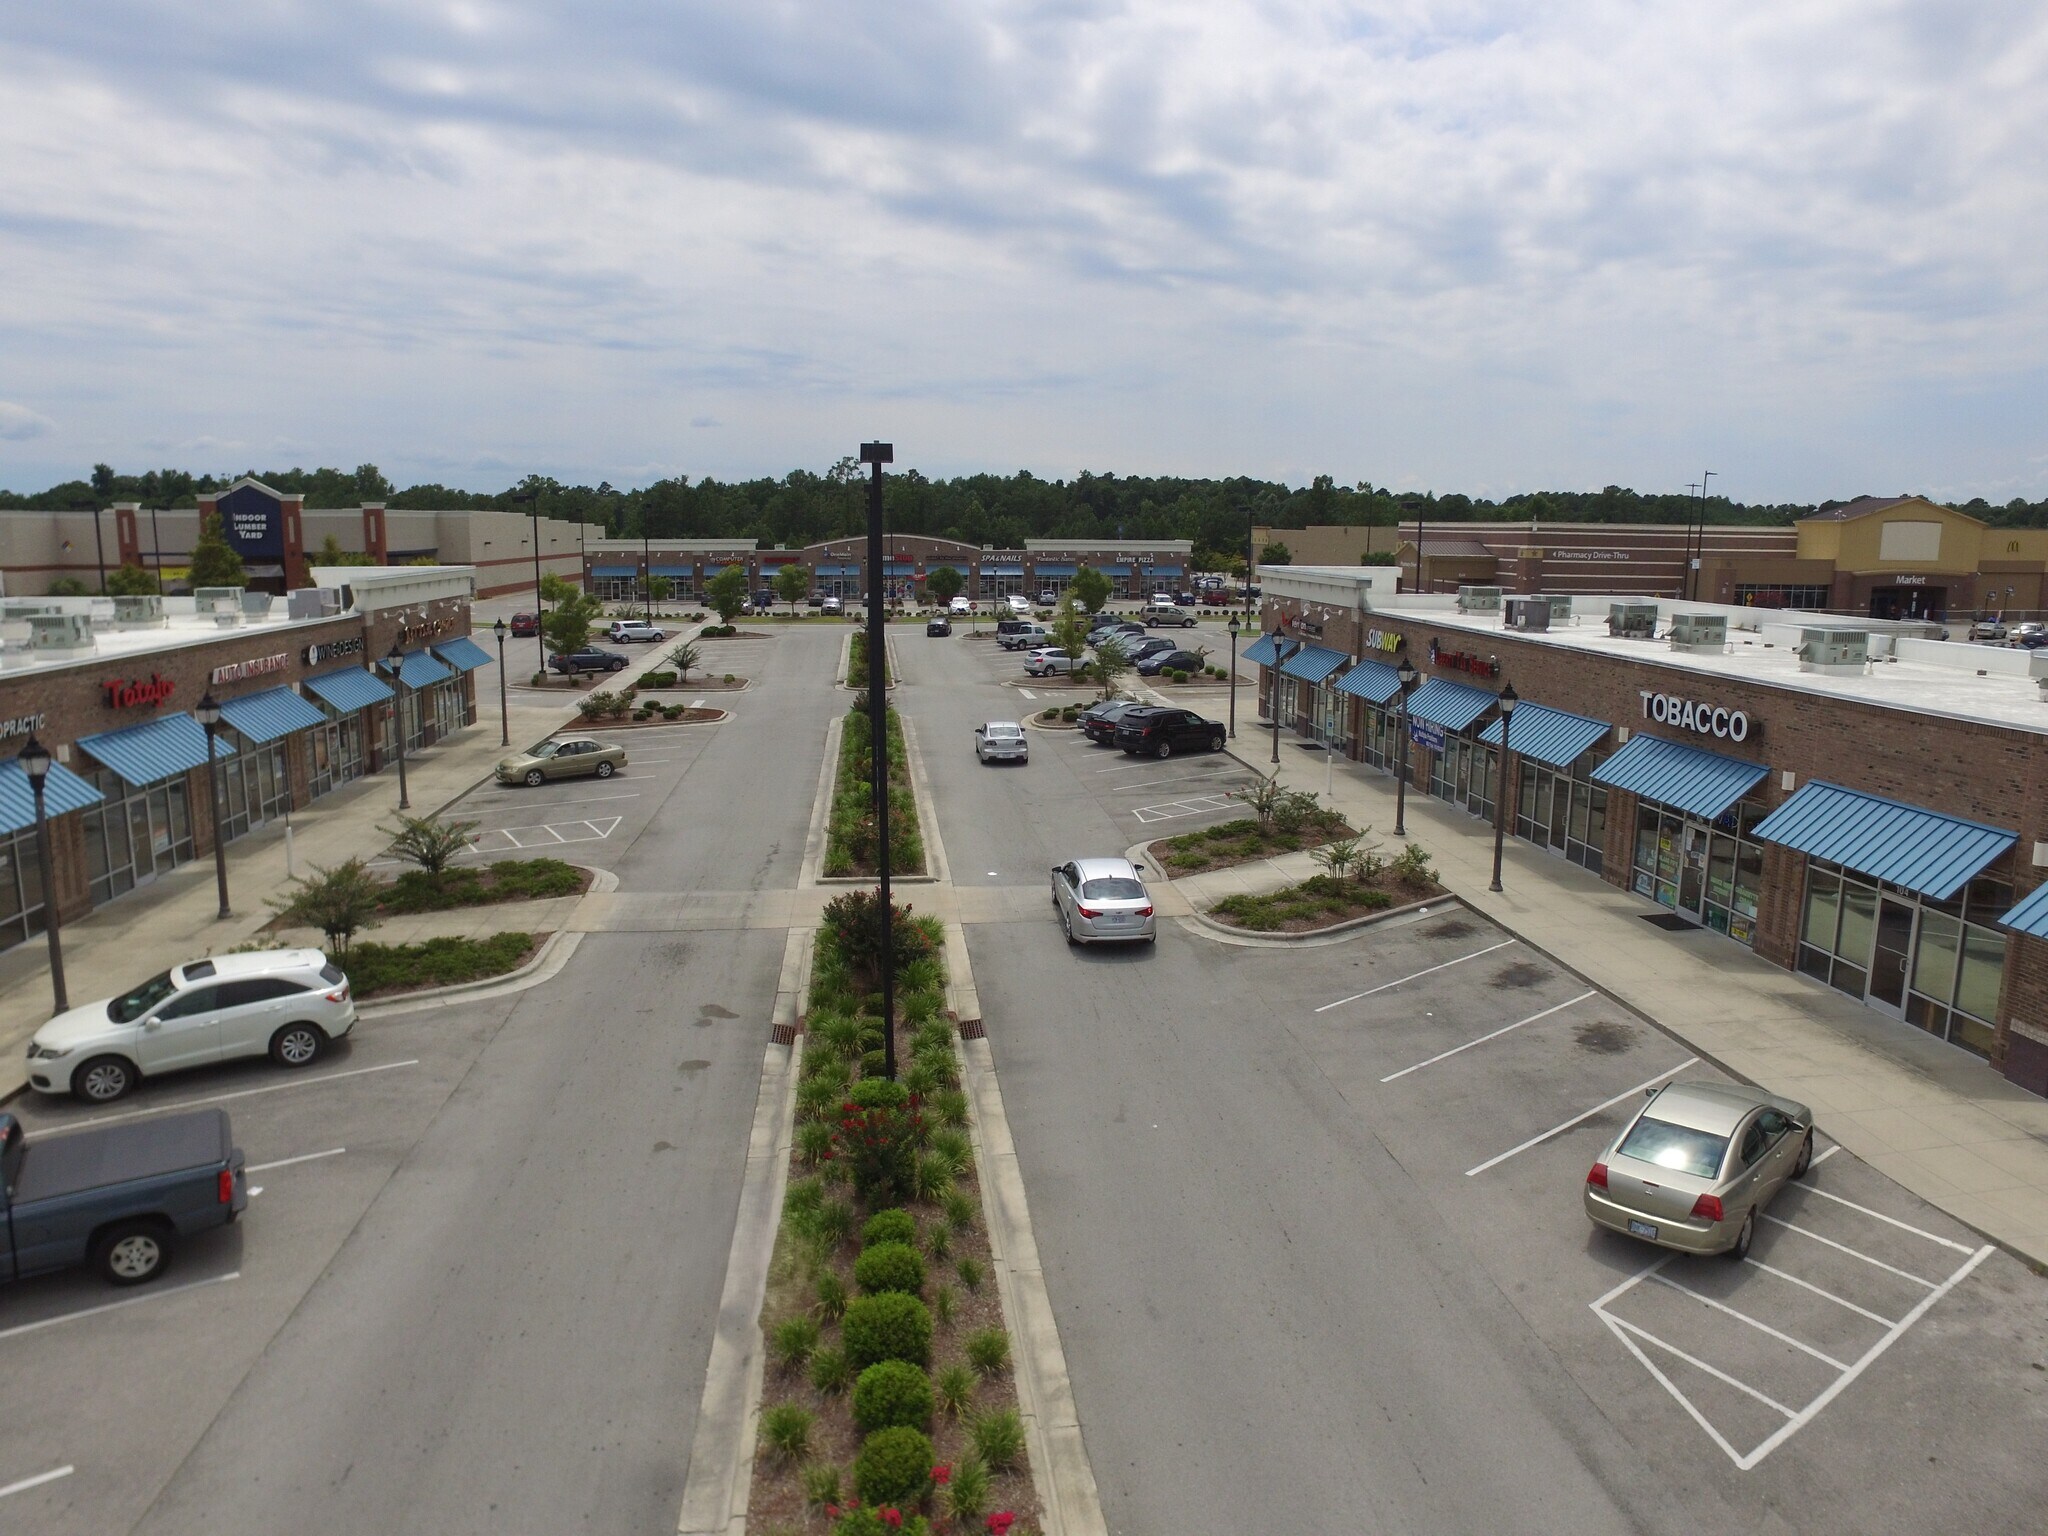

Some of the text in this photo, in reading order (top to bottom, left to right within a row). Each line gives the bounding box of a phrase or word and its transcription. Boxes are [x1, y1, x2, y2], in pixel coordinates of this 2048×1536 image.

[233, 513, 267, 521] INDOOR
[239, 530, 263, 539] YARD
[1557, 551, 1630, 560] Pharmacy Drive-Thru
[1896, 575, 1926, 585] Market
[1366, 628, 1402, 653] SUBWAY
[218, 653, 290, 682] AUTO INSURANCE
[1640, 690, 1748, 742] TOBACCO
[0, 713, 46, 740] OPRACTIC
